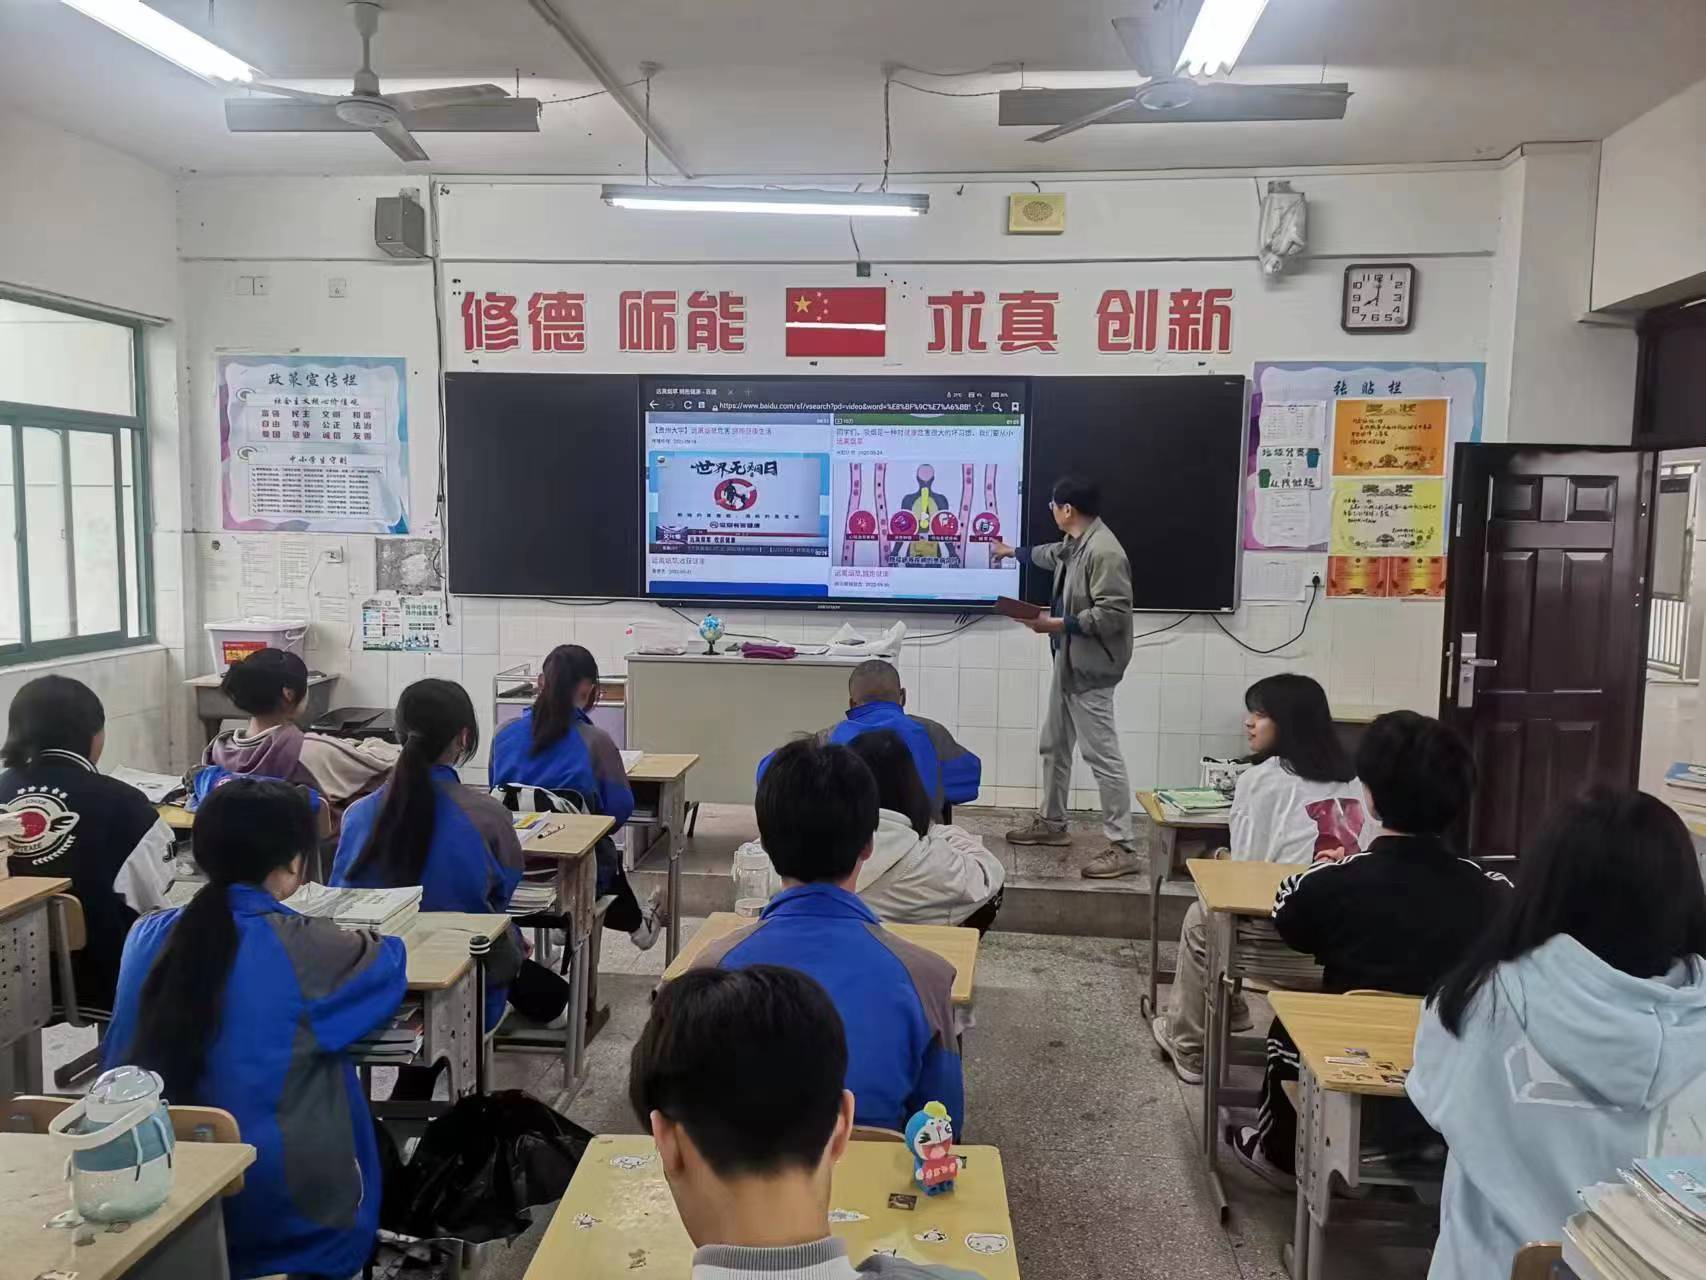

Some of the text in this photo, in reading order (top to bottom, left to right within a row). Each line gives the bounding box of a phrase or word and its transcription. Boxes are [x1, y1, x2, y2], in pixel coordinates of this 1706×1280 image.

[1394, 281, 1403, 289] 2
[1352, 294, 1361, 302] 9
[1393, 293, 1402, 302] 3
[1351, 306, 1360, 314] 8
[1392, 306, 1400, 314] 4
[461, 290, 588, 353] 修德
[1096, 287, 1236, 354] 创新
[1360, 313, 1367, 322] 7
[1371, 313, 1380, 322] 6
[1384, 313, 1393, 322] 5
[268, 371, 359, 388] 政策宣传栏
[1333, 380, 1403, 396] 张贴栏
[274, 396, 360, 407] 社会主义核心价值观
[292, 410, 311, 418] 民主
[322, 410, 341, 419] 文明
[352, 411, 372, 420] 和谐
[261, 420, 372, 430] 自由 平等 公正 法治
[322, 431, 341, 440] 诚信
[289, 455, 347, 466] 中小学生守则
